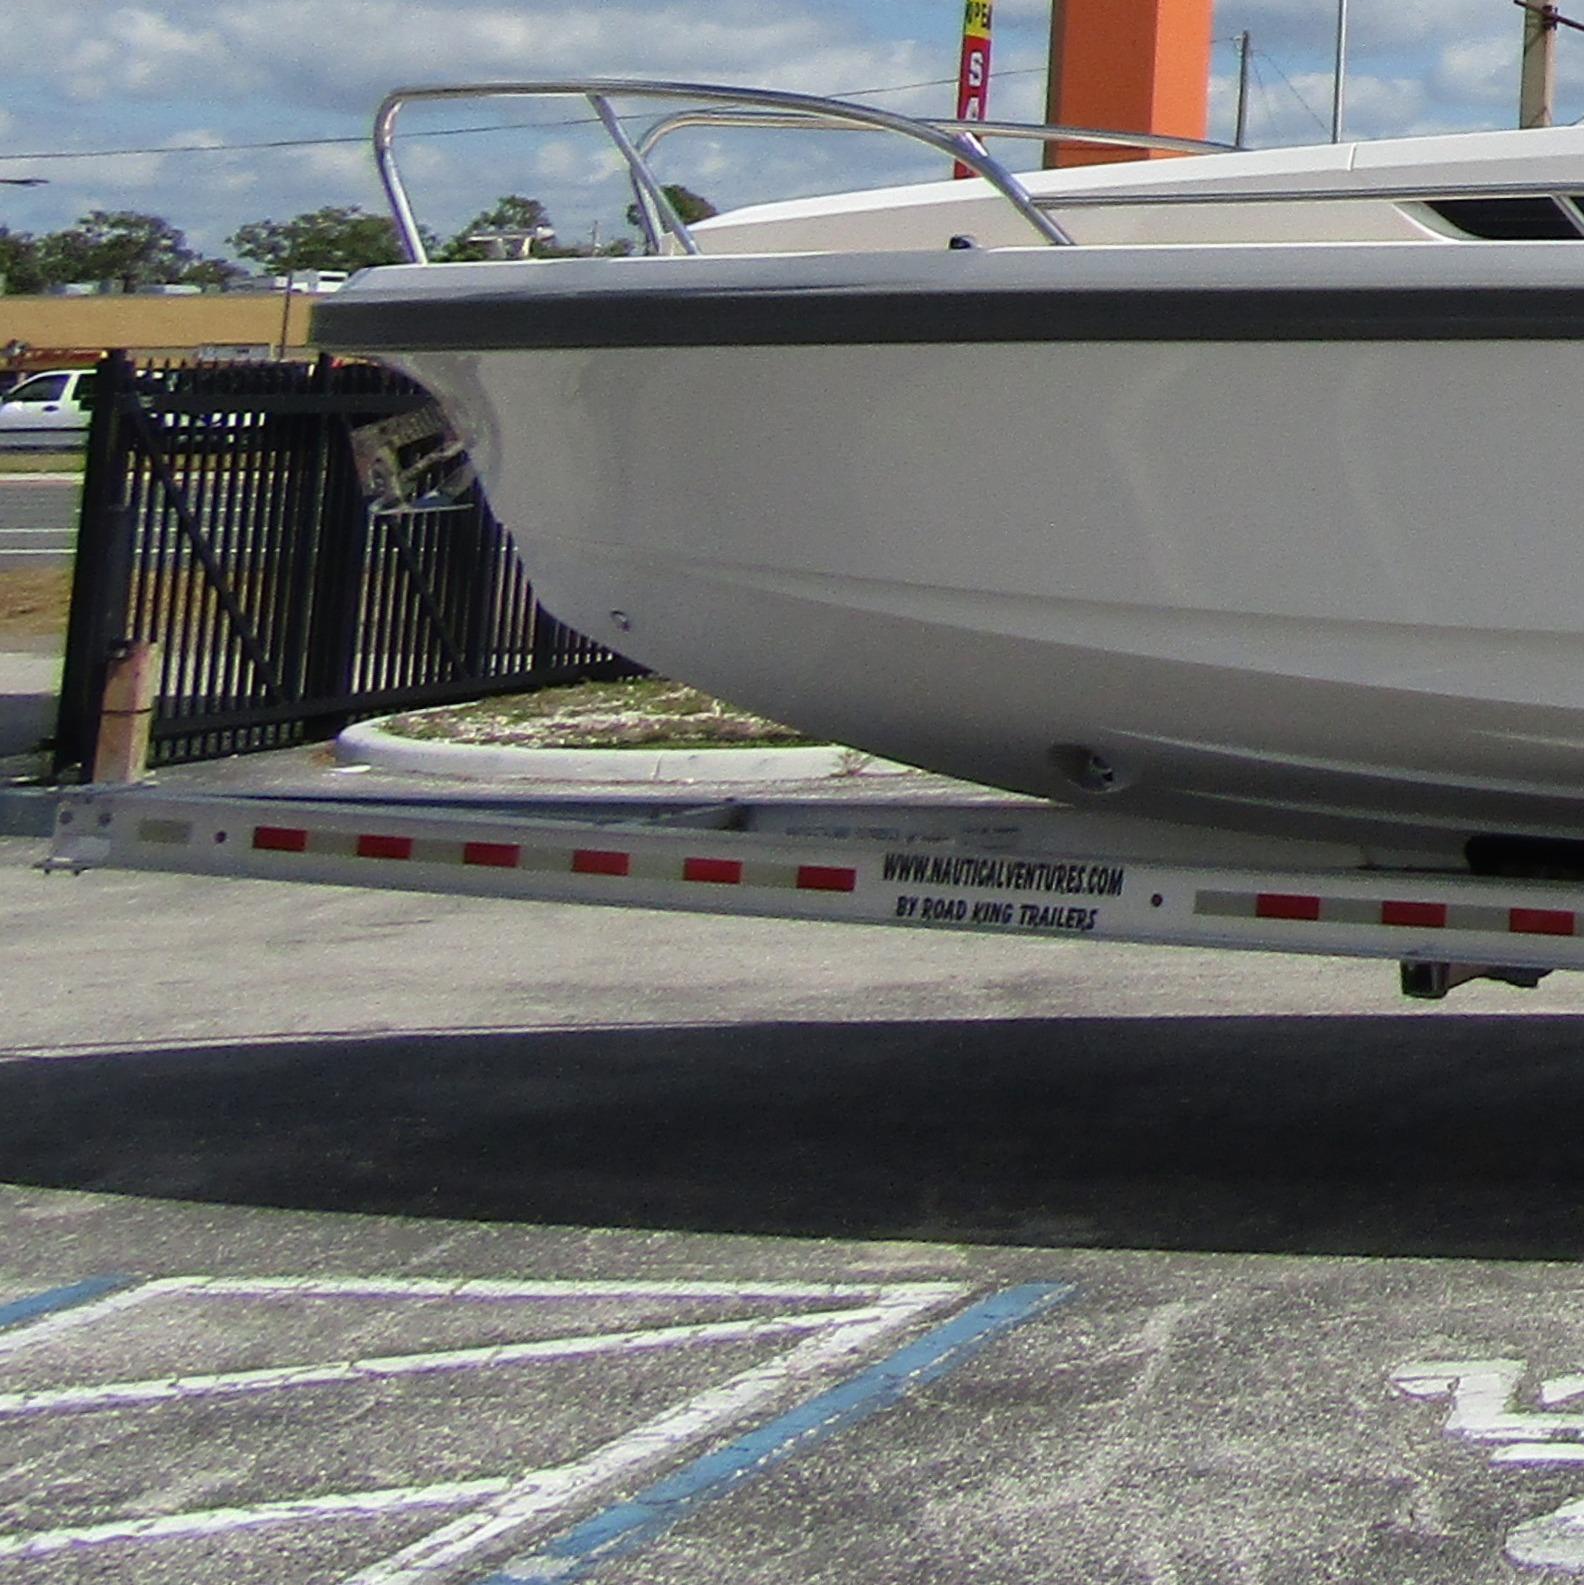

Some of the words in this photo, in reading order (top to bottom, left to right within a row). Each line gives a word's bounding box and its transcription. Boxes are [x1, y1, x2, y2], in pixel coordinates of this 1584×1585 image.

[883, 853, 1125, 897] WWW.NAUTICALVENTURES.COM
[896, 896, 919, 918] BY
[922, 897, 968, 922] ROAD
[971, 902, 1013, 926] KING
[1020, 904, 1099, 932] TRAILERS
